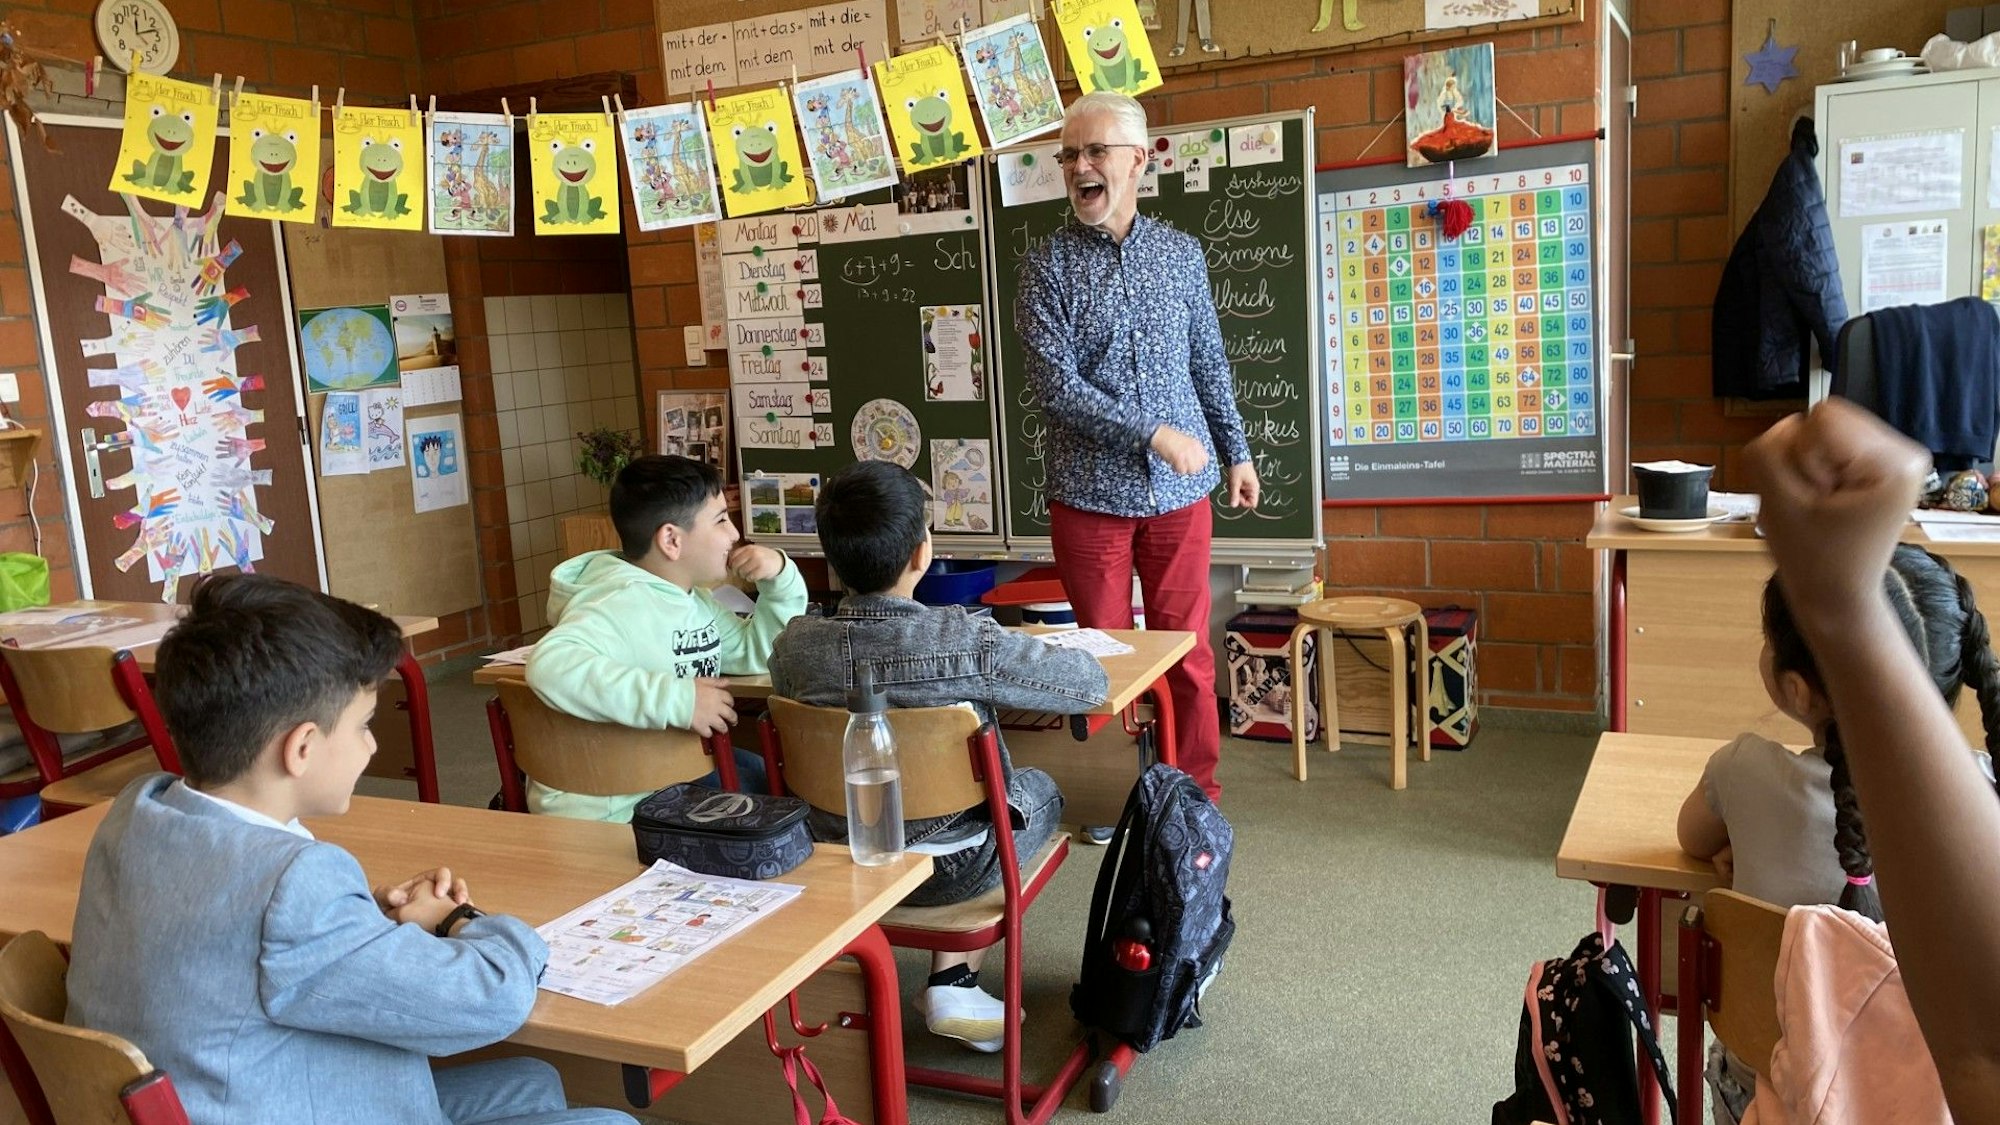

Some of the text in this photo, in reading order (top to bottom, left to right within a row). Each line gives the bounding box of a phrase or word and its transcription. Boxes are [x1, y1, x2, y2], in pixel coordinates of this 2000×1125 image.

[113, 12, 124, 24] 10
[123, 6, 129, 17] 11
[130, 4, 139, 16] 12
[143, 9, 147, 20] 1
[112, 25, 119, 36] 9
[149, 17, 156, 28] 2
[119, 39, 126, 50] 8
[155, 31, 160, 42] 3
[814, 34, 864, 56] mit der
[146, 51, 152, 62] 5
[152, 44, 158, 54] 4
[739, 49, 793, 69] mit dem
[671, 55, 726, 80] mit dem
[1180, 136, 1210, 155] das
[1347, 169, 1581, 206] 1 2 3 4 5 6 7 8 9 10
[844, 210, 876, 233] Mai
[1204, 200, 1260, 233] Else
[1326, 192, 1582, 231] 1 1 2 3 7 8 9 10
[736, 218, 777, 244] Montag
[1326, 218, 1583, 255] 2 2 4 6 8 12 14 16 18 20
[934, 236, 975, 270] Sch
[1205, 242, 1294, 268] Simone
[739, 258, 786, 281] Dienstag
[1328, 260, 1402, 278] 3 9
[738, 286, 790, 312] Mittwoch
[1328, 291, 1334, 301] 4
[1330, 293, 1586, 325] 5 5 10 15 20 25 30 35 40 45 50
[737, 322, 797, 346] Donnerstag
[1330, 326, 1482, 348] 6 36
[740, 354, 781, 380] Freitag
[1331, 348, 1509, 371] 7 49
[1332, 371, 1534, 394] 8 64
[749, 389, 793, 415] Samstag
[1333, 392, 1561, 416] 9 81
[750, 422, 800, 448] Sonntag
[1243, 410, 1300, 443] arkus
[1332, 416, 1590, 439] 10 10 20 30 40 50 60 70 80 90 100
[1255, 449, 1291, 479] tor
[1355, 460, 1445, 471] Die Einmaleins-Tafel
[1544, 460, 1596, 468] MATERIAL
[1247, 668, 1290, 705] KAPLA
